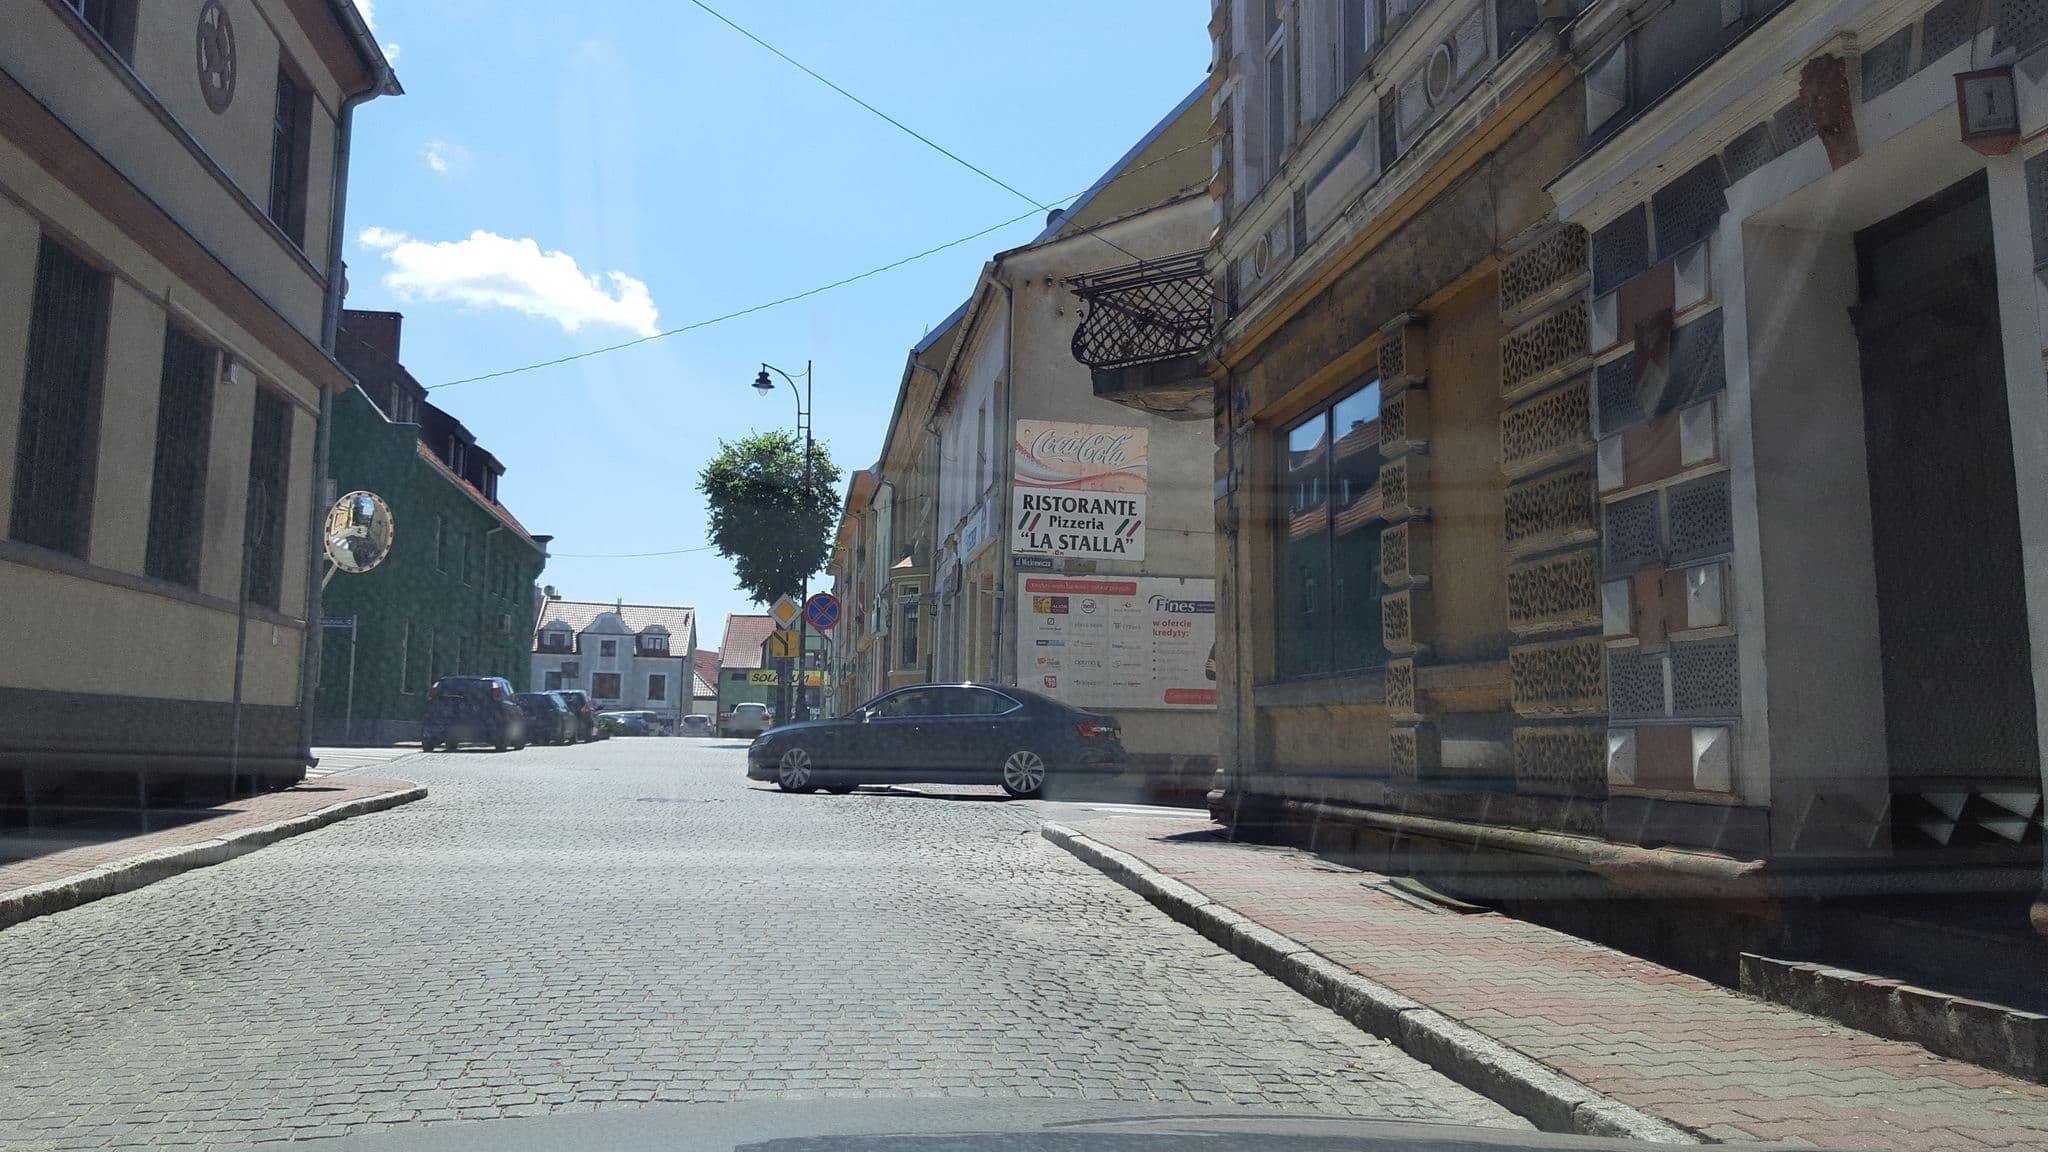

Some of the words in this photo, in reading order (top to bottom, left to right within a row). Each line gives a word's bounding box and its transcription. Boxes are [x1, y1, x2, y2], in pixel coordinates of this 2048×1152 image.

[1023, 494, 1137, 516] RISTORANTE
[1049, 515, 1105, 530] Pizzeria
[1155, 597, 1196, 613] Fines
[1161, 619, 1192, 628] ofercie
[1152, 628, 1189, 639] kredyty:
[751, 673, 810, 684] SOLAUM
